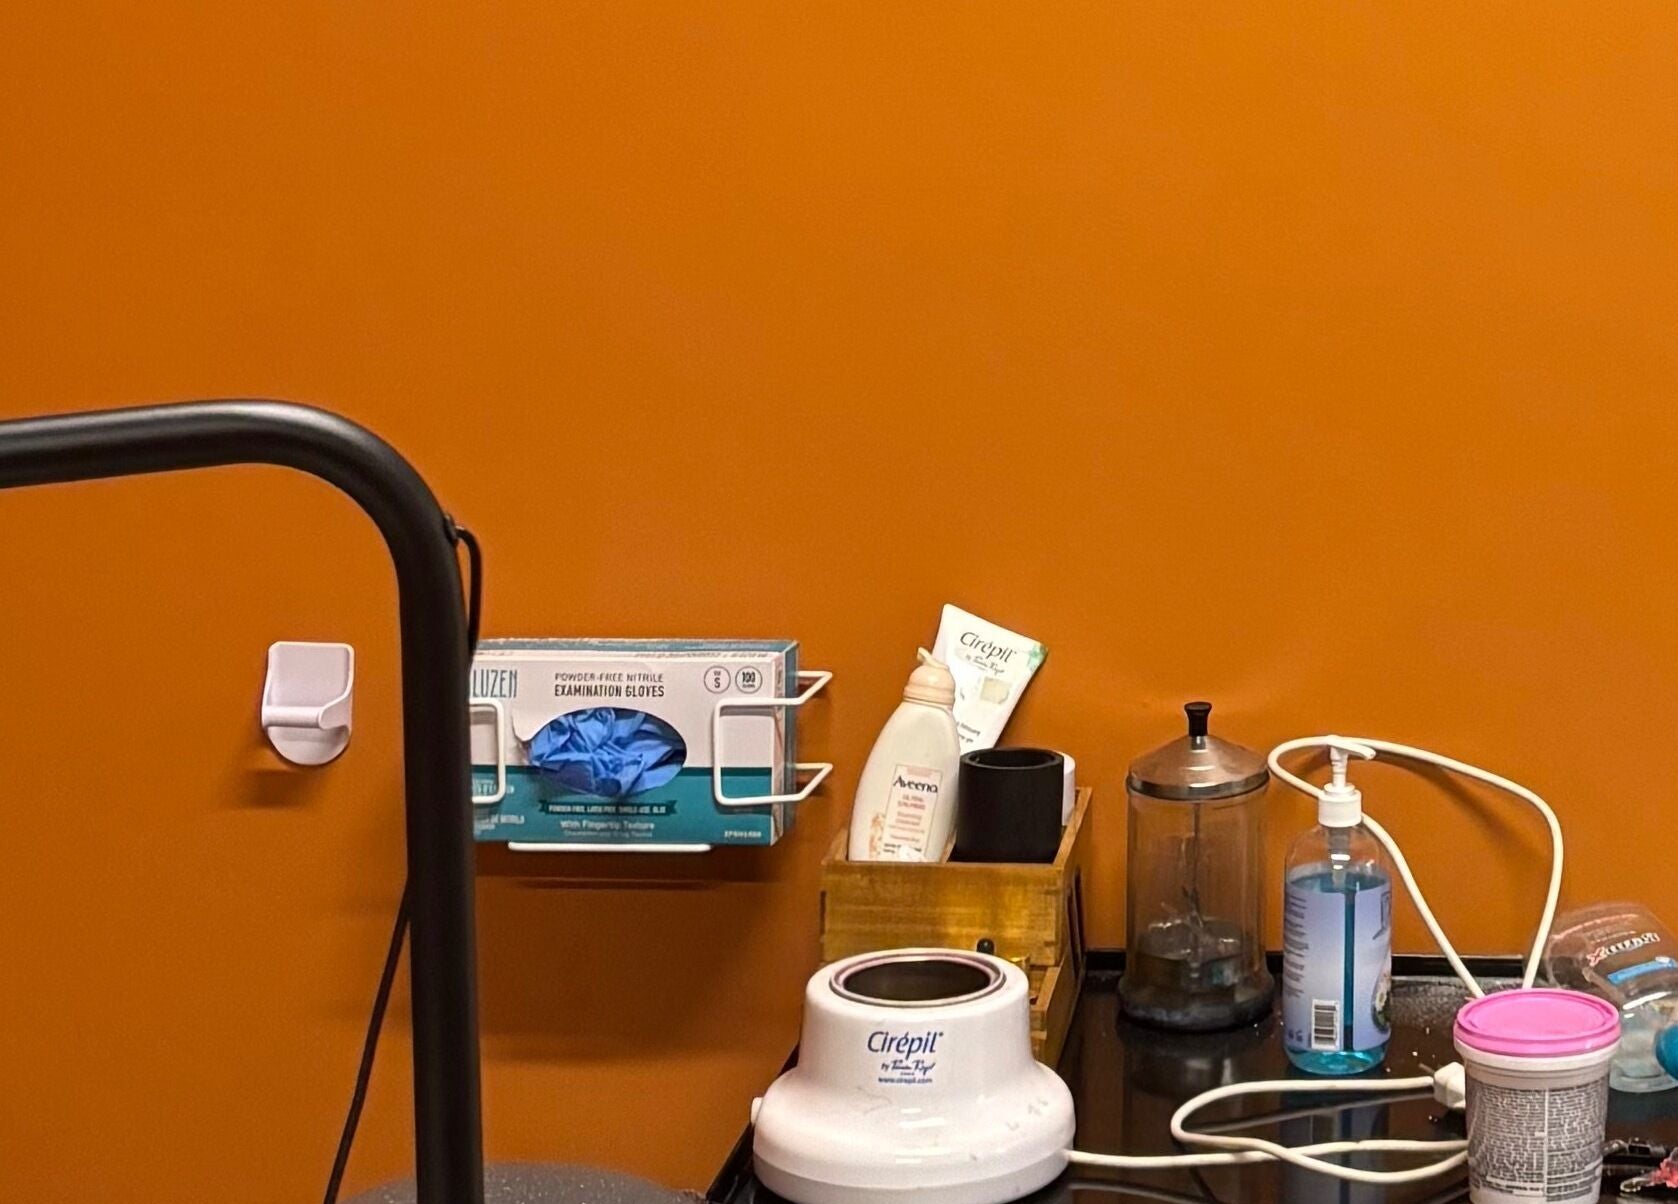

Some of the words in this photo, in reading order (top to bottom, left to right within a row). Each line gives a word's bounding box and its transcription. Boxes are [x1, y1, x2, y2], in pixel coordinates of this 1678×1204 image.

[472, 669, 518, 698] LUZEN
[626, 673, 664, 683] NITRILE
[554, 684, 622, 697] EXAMINATION
[624, 684, 665, 698] GLOVES
[867, 1031, 937, 1060] Cirépil
